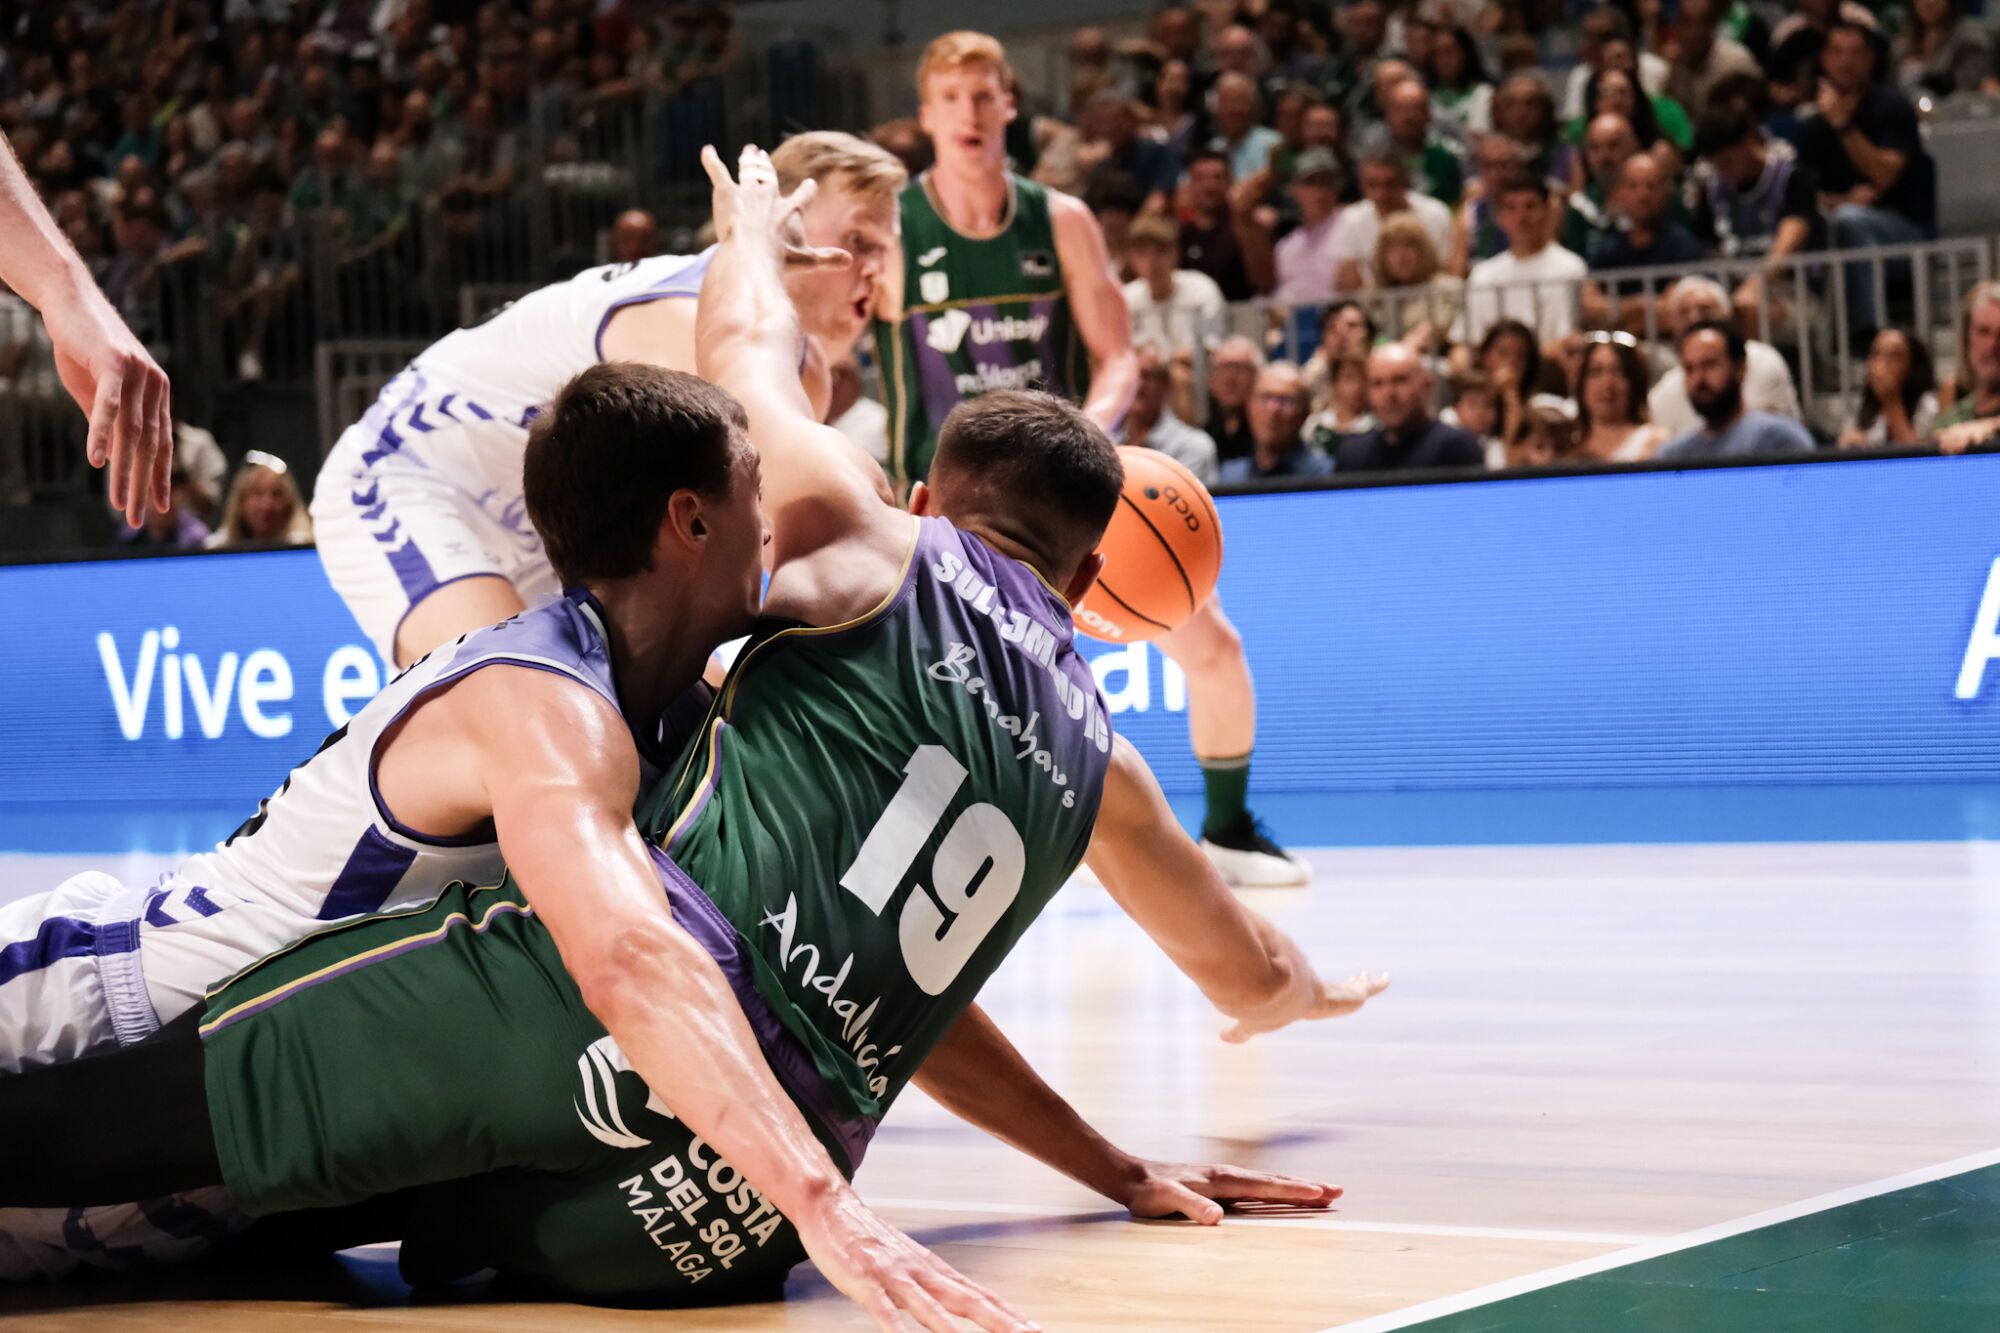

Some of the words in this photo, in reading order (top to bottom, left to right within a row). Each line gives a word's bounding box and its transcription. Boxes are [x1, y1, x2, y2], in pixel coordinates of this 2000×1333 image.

[97, 626, 294, 741] Vive
[322, 645, 402, 732] e
[928, 642, 1075, 808] Benahavs
[839, 744, 1026, 996] 19
[617, 1173, 713, 1284] MÁLAGA
[650, 1154, 709, 1227] DEL
[699, 1218, 747, 1270] SOL
[687, 1135, 783, 1248] COSTA
